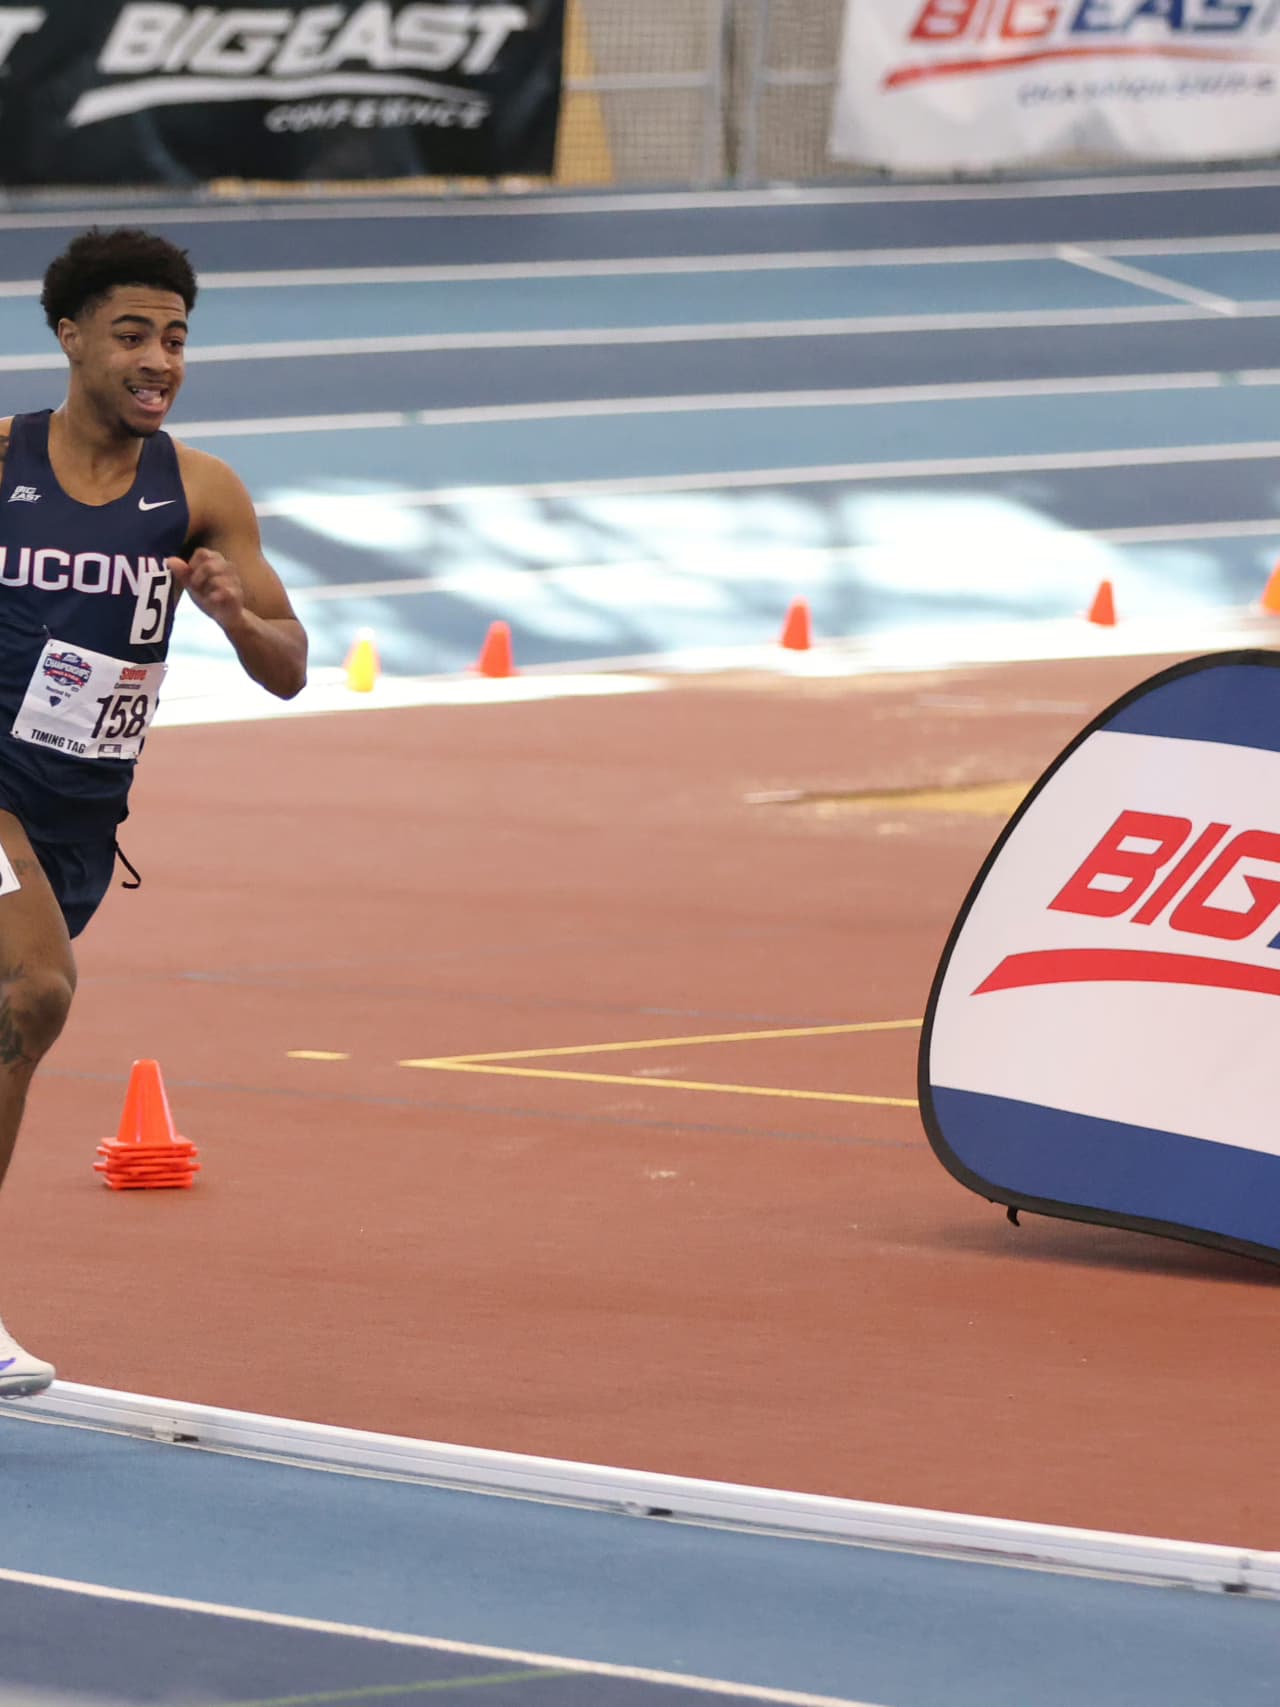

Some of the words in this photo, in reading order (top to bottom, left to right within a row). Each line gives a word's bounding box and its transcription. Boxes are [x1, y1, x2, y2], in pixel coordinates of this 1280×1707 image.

[908, 0, 1280, 41] BIGEAS
[139, 574, 168, 641] 5
[90, 693, 149, 740] 158
[31, 728, 65, 748] TIMING
[67, 738, 87, 755] TAG
[1046, 809, 1280, 950] BIG
